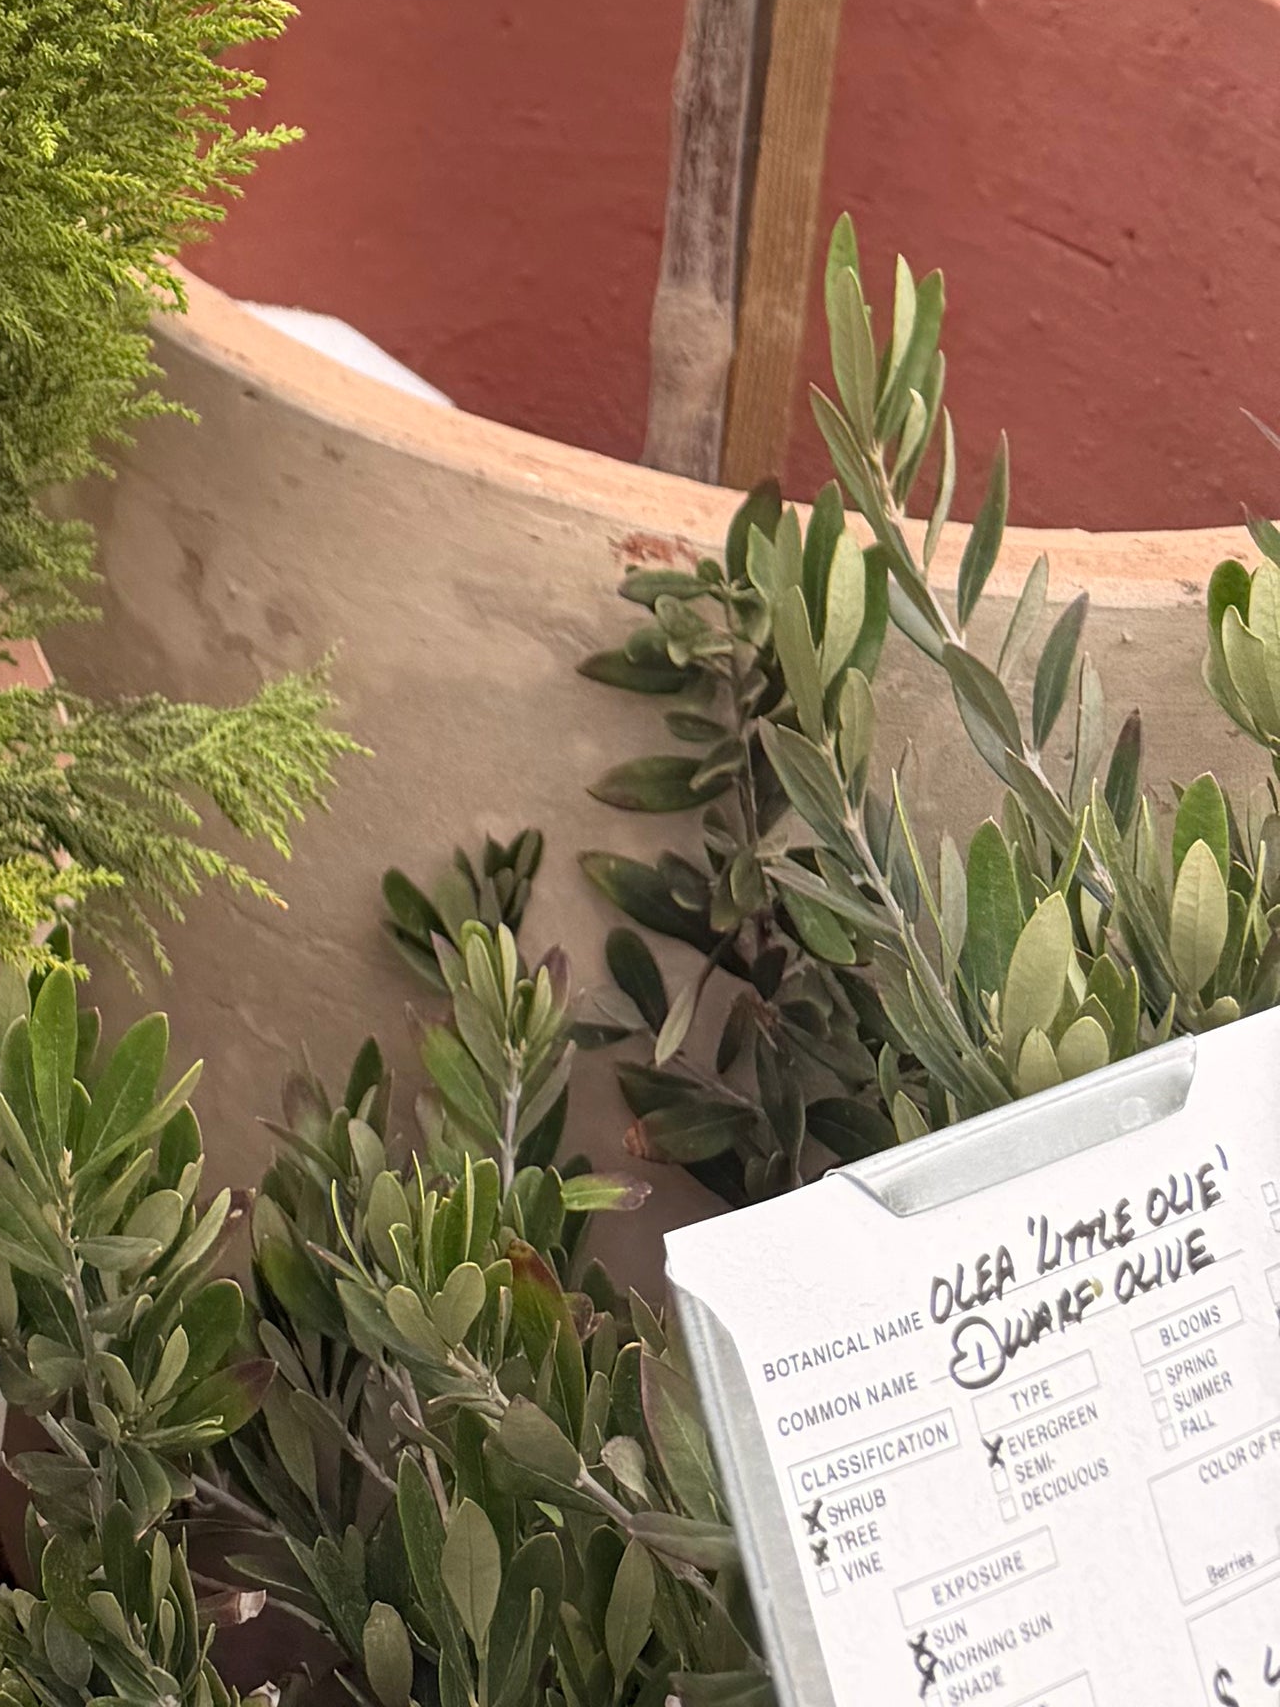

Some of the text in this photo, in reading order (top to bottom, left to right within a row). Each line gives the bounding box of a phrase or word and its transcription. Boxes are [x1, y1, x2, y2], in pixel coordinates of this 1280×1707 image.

[930, 1245, 1016, 1324] OLEA
[950, 1228, 1216, 1390] DWARF OLIVE
[1159, 1305, 1222, 1347] BLOOMS
[763, 1311, 924, 1382] BOTANICAL NAME
[1165, 1348, 1218, 1386] SPRING
[777, 1371, 918, 1436] COMMON NAME
[1010, 1379, 1054, 1412] TYPE
[1172, 1370, 1233, 1412] SUMMER
[1007, 1401, 1099, 1456] EVERGREEN
[1180, 1409, 1218, 1438] FALL
[801, 1421, 950, 1492] CLASSIFICATION
[1014, 1451, 1056, 1484] SEMI-
[1198, 1445, 1247, 1485] COLOR
[1248, 1435, 1268, 1460] OF
[1021, 1457, 1109, 1511] DECIDUOUS
[827, 1488, 887, 1526] SHRUB
[833, 1521, 881, 1554] TREE
[842, 1552, 883, 1582] VINE
[931, 1550, 1026, 1606] EXPOSURE
[1206, 1551, 1256, 1586] Berries
[931, 1617, 968, 1649] SUN
[939, 1610, 1054, 1677] MORNING SUN
[947, 1665, 1006, 1707] SHADE
